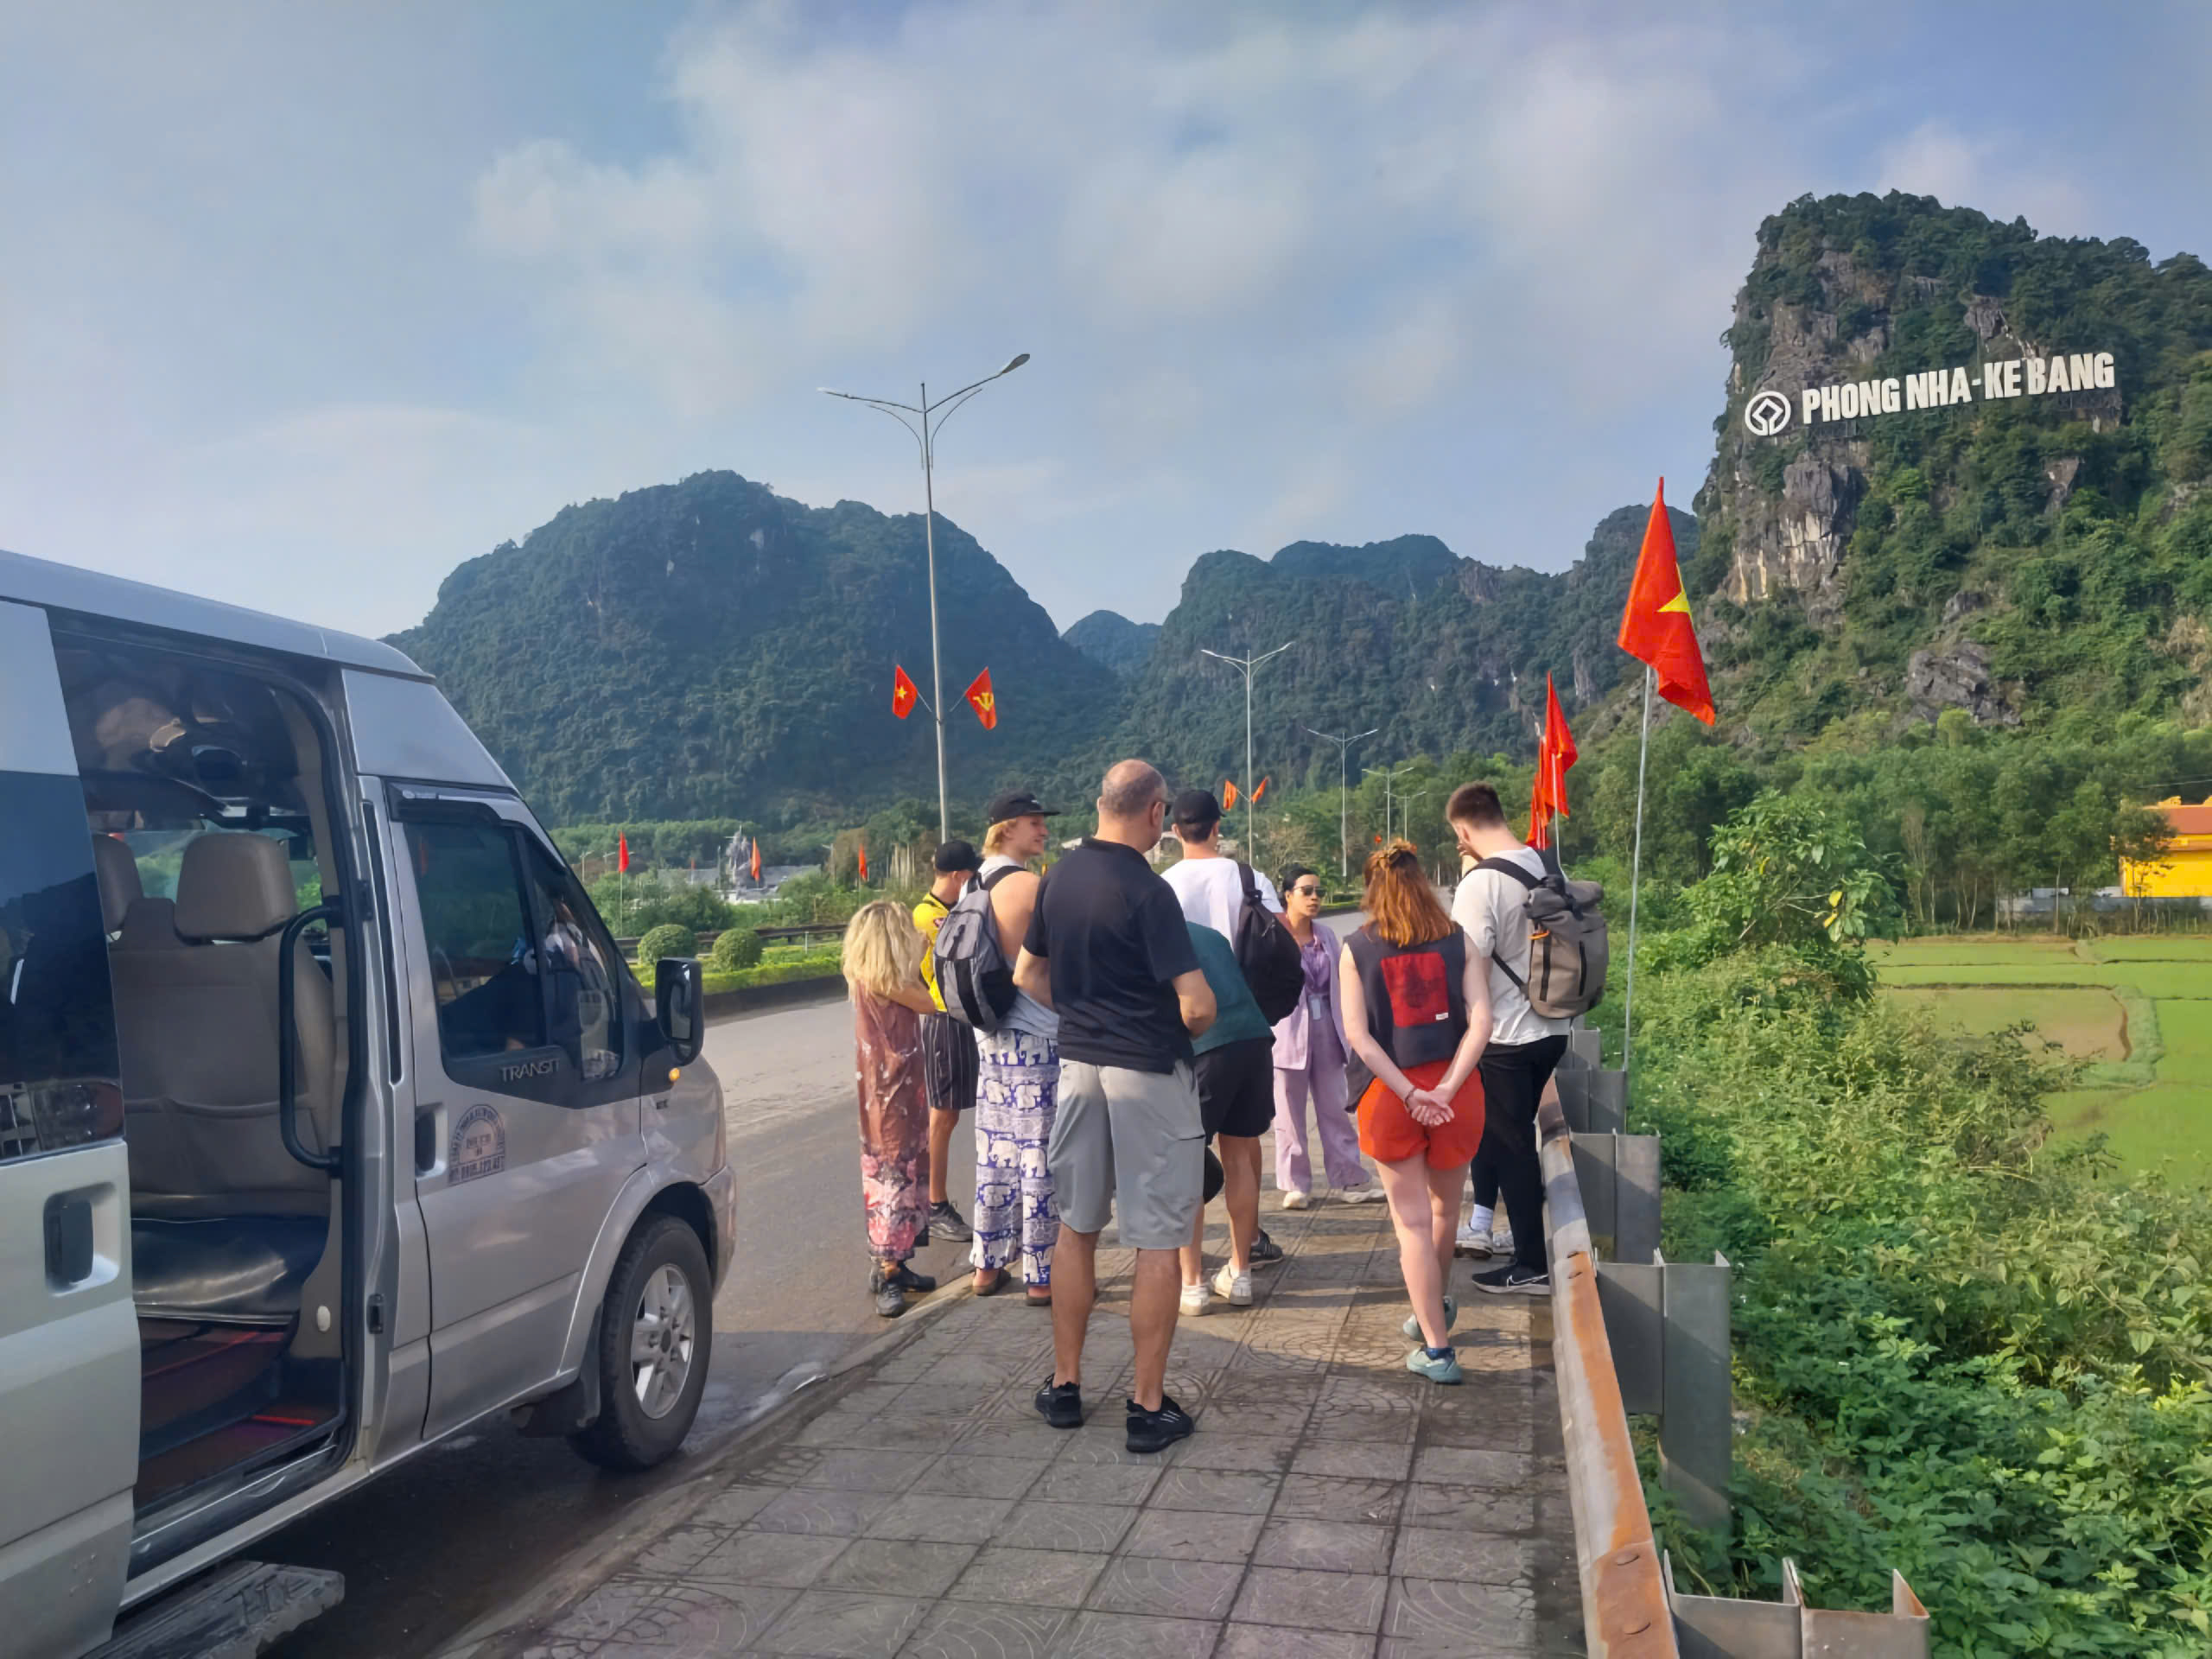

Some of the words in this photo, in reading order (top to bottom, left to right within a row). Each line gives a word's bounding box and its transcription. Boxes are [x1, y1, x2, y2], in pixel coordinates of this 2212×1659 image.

[1802, 378, 1901, 424] PHONG
[2027, 353, 2115, 395] BANG
[500, 1058, 560, 1082] TRANSIT
